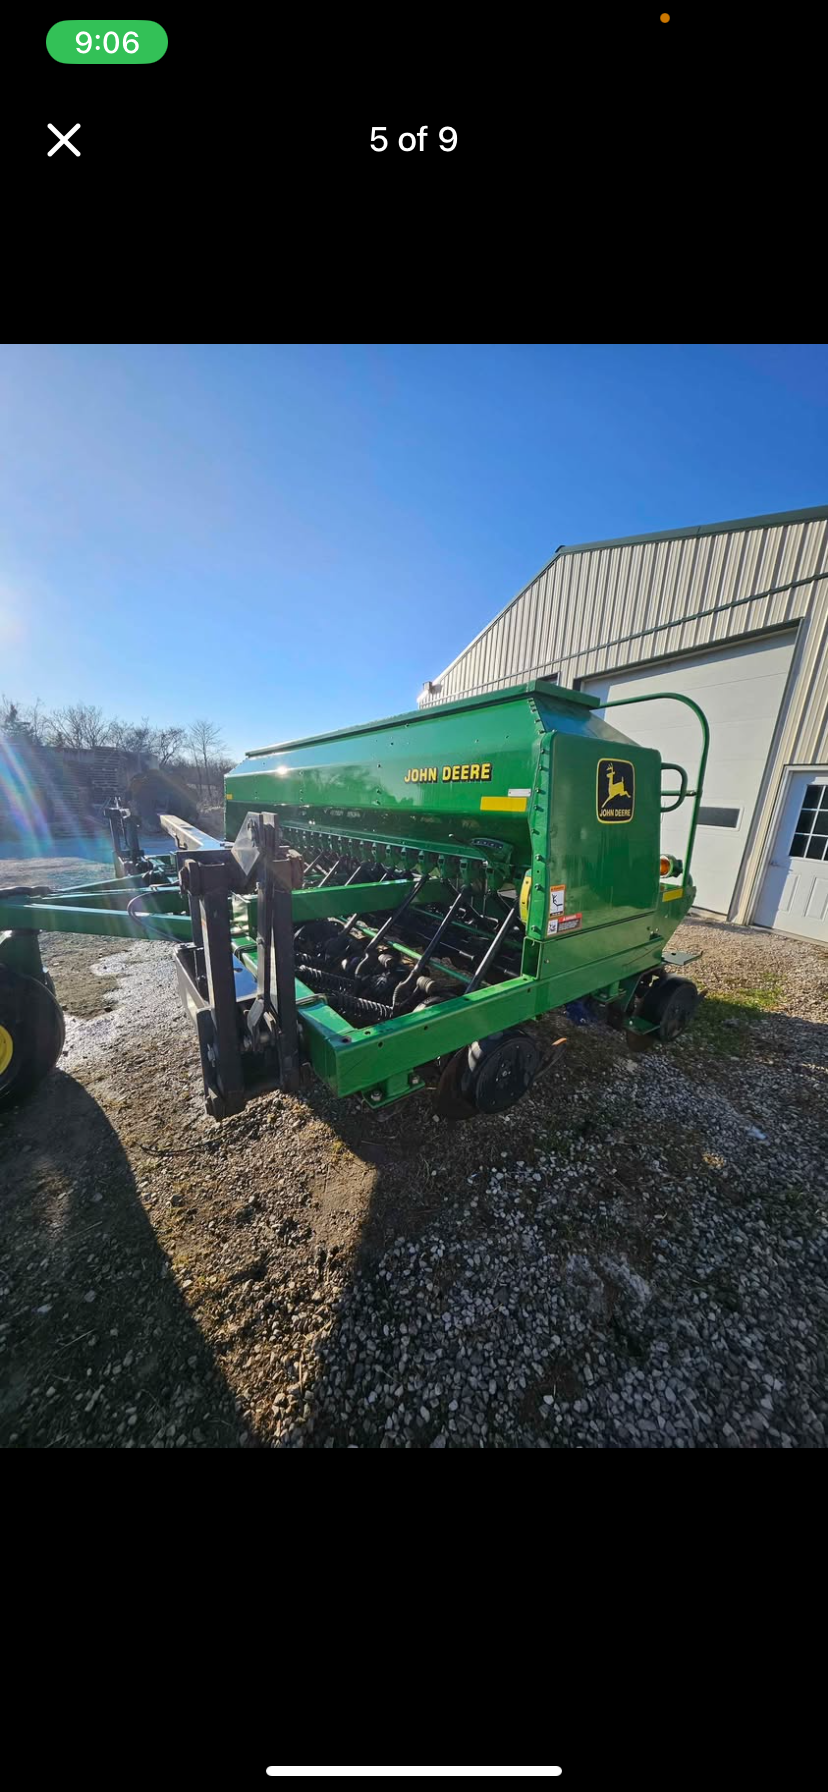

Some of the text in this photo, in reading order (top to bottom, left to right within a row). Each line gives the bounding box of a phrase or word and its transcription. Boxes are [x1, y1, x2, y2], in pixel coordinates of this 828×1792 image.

[404, 763, 492, 783] JOHN DEERE
[600, 809, 631, 817] JOHN DEERE
